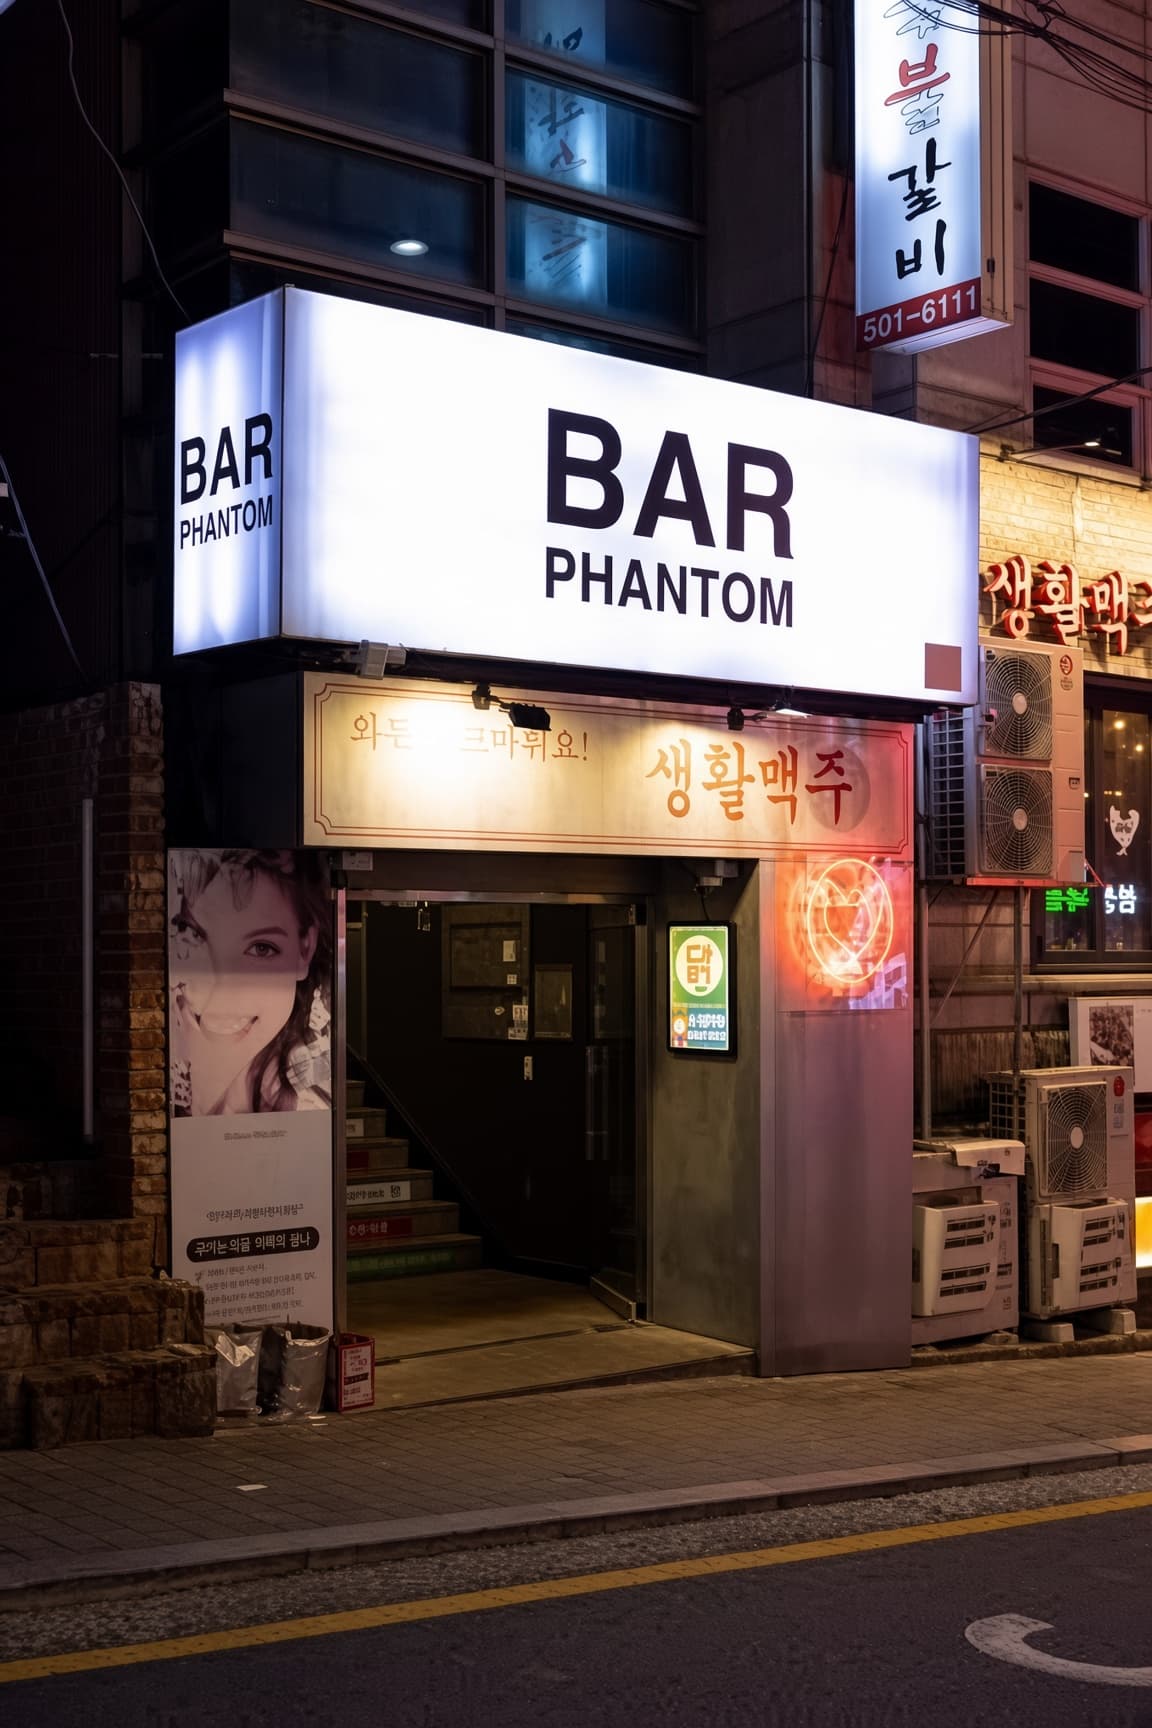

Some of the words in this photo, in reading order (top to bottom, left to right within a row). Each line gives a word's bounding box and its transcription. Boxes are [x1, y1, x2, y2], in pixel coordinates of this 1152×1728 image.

[863, 285, 976, 343] 501-6111
[180, 412, 273, 506] BAR
[547, 408, 794, 559] BAR
[180, 495, 273, 550] PHANTOM
[545, 546, 793, 628] PHANTOM
[645, 738, 852, 825] 생활맥주
